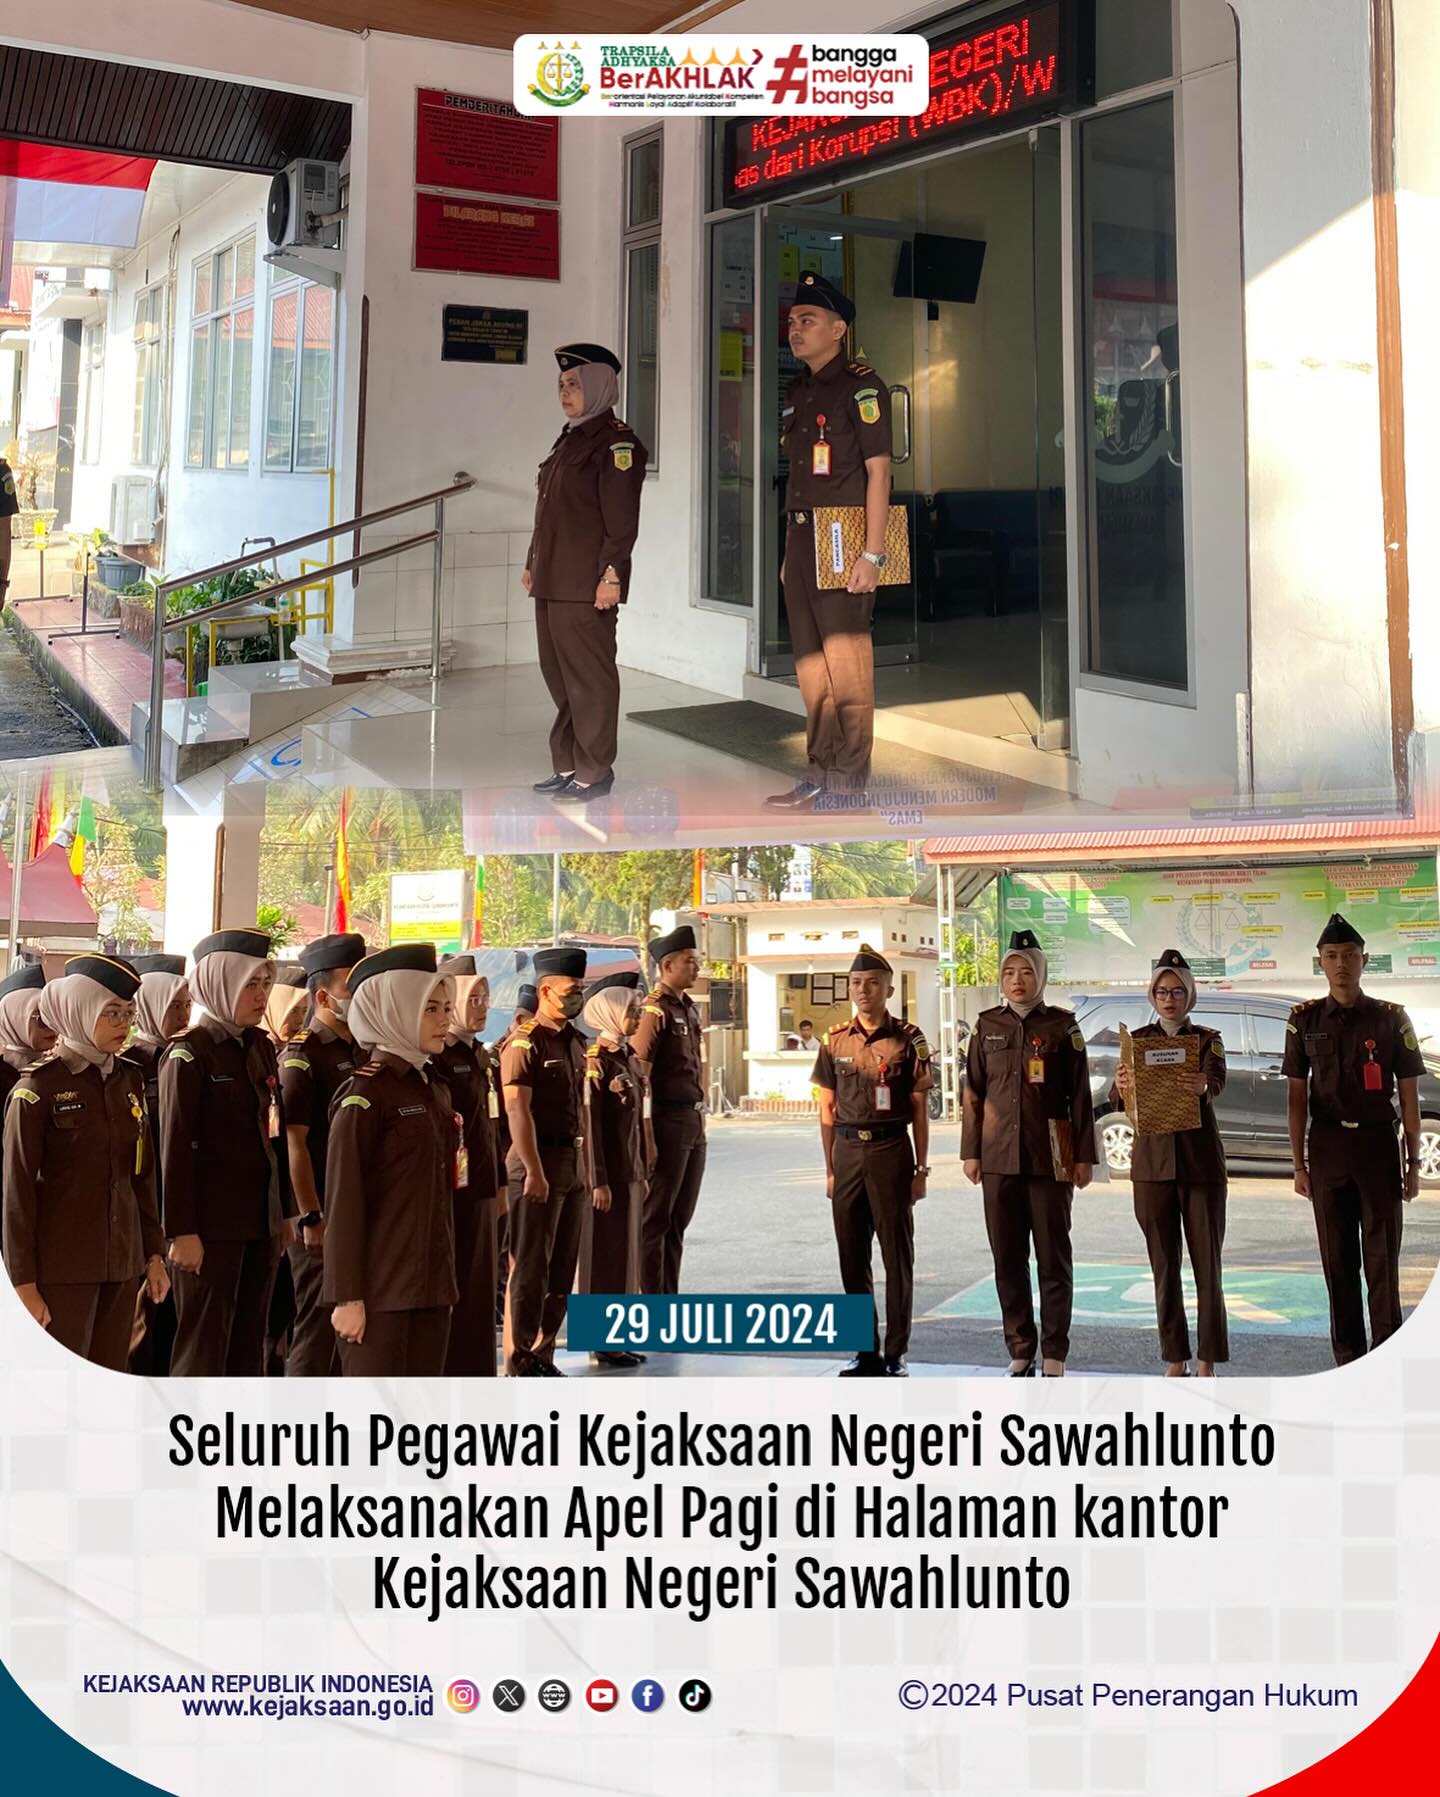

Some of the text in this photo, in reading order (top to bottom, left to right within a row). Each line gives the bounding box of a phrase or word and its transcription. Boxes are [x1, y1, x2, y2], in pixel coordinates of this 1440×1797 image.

[929, 19, 1030, 88] EGERI
[763, 142, 804, 180] dari
[808, 116, 899, 167] Korupsi
